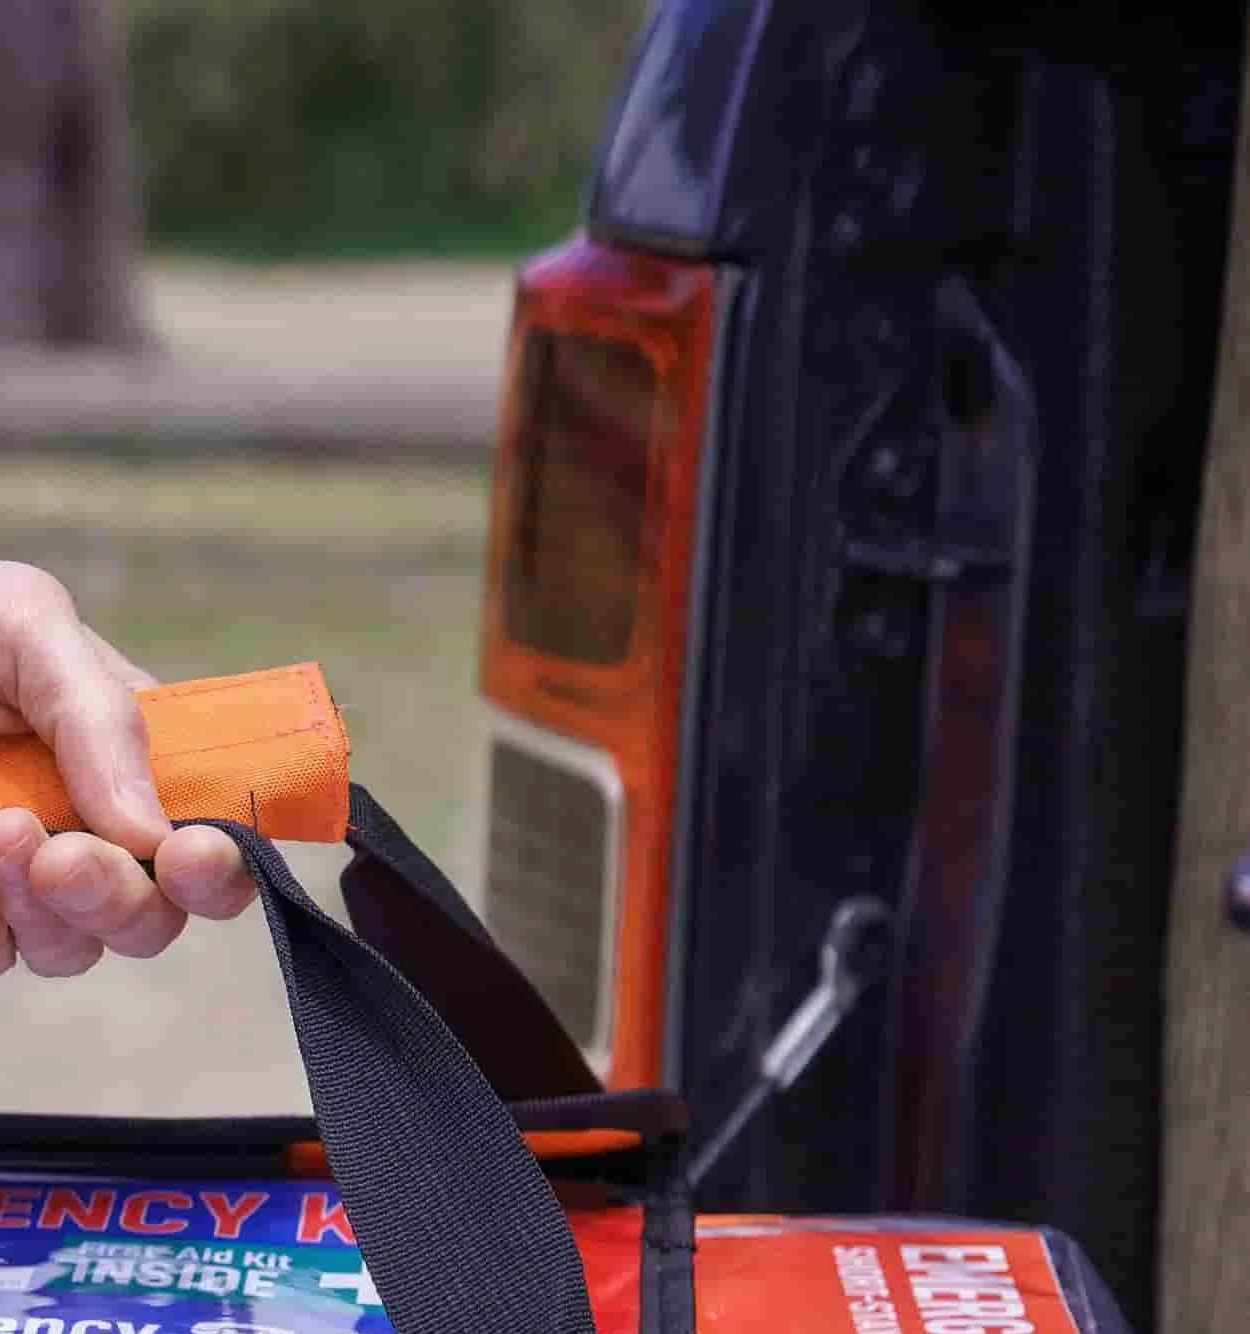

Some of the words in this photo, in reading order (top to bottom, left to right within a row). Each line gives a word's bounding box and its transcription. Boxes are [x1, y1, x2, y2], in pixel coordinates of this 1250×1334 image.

[176, 1247, 234, 1265] Aid
[243, 1251, 293, 1271] Kit
[71, 1257, 280, 1299] INSIDE
